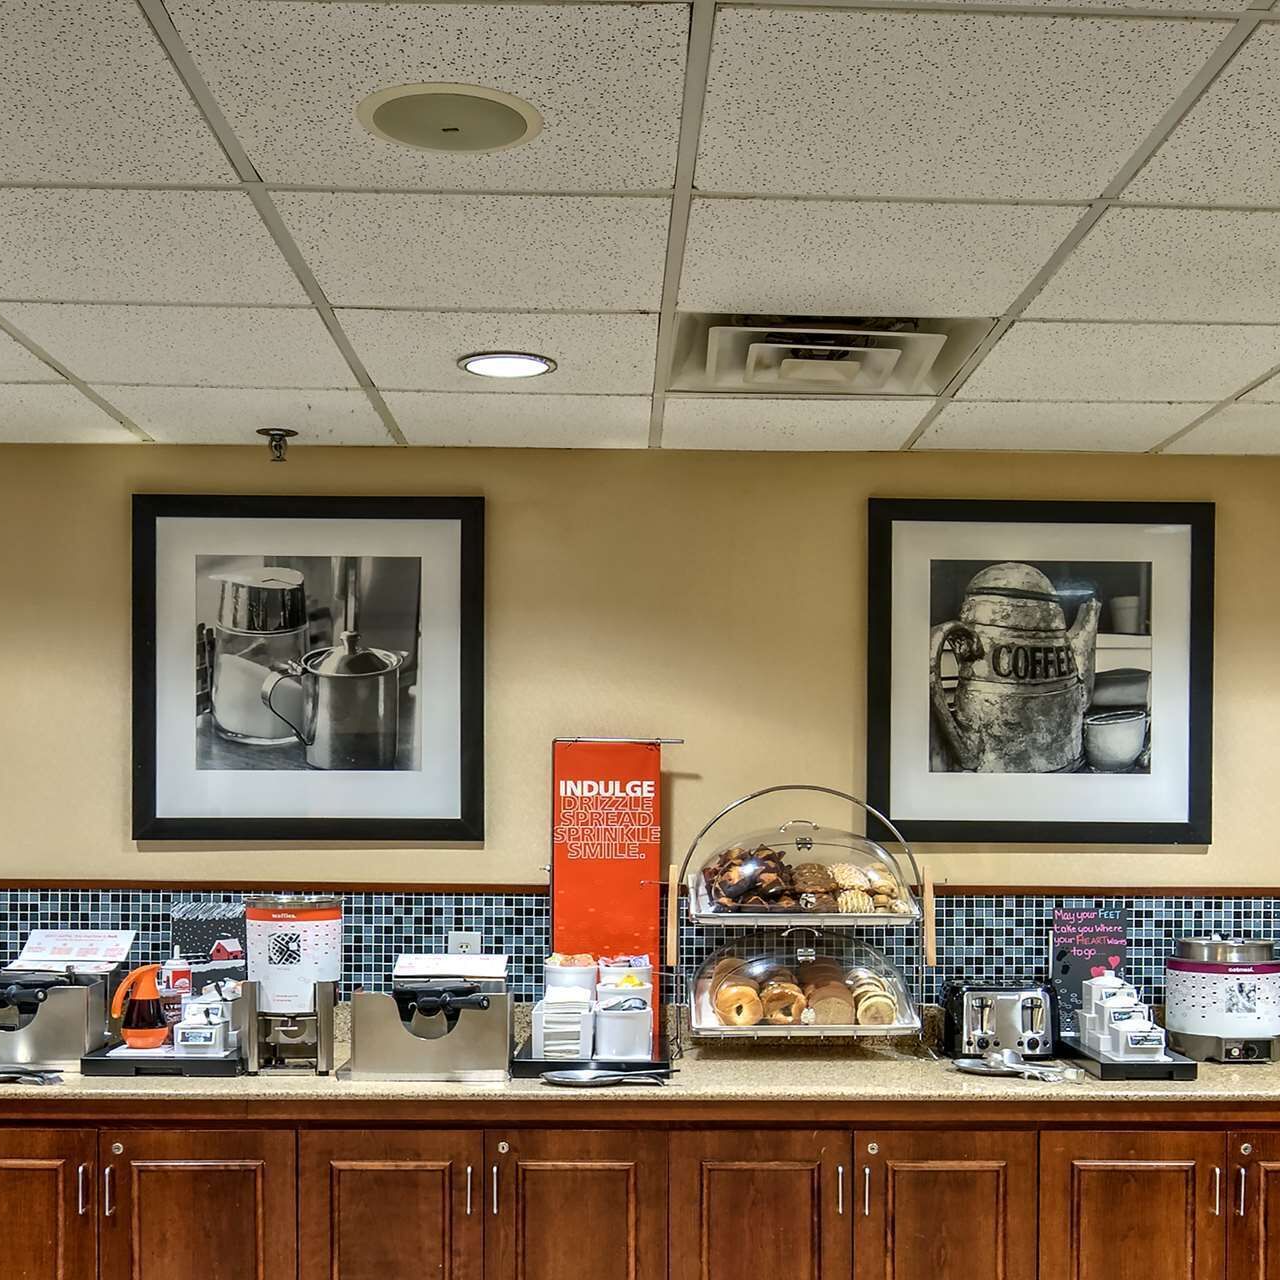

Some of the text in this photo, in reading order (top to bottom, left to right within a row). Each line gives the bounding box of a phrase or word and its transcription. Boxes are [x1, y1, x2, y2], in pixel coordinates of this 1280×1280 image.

[559, 780, 656, 797] INDULGE
[561, 795, 654, 812] DRIZZLE
[559, 810, 654, 827] SPREAD
[553, 826, 661, 844] SPRINKLE
[567, 842, 646, 860] SMILE.
[1054, 908, 1121, 924] May your FEET
[1053, 923, 1077, 934] take
[1077, 926, 1094, 936] you
[1053, 937, 1076, 947] your
[1071, 946, 1097, 960] to go
